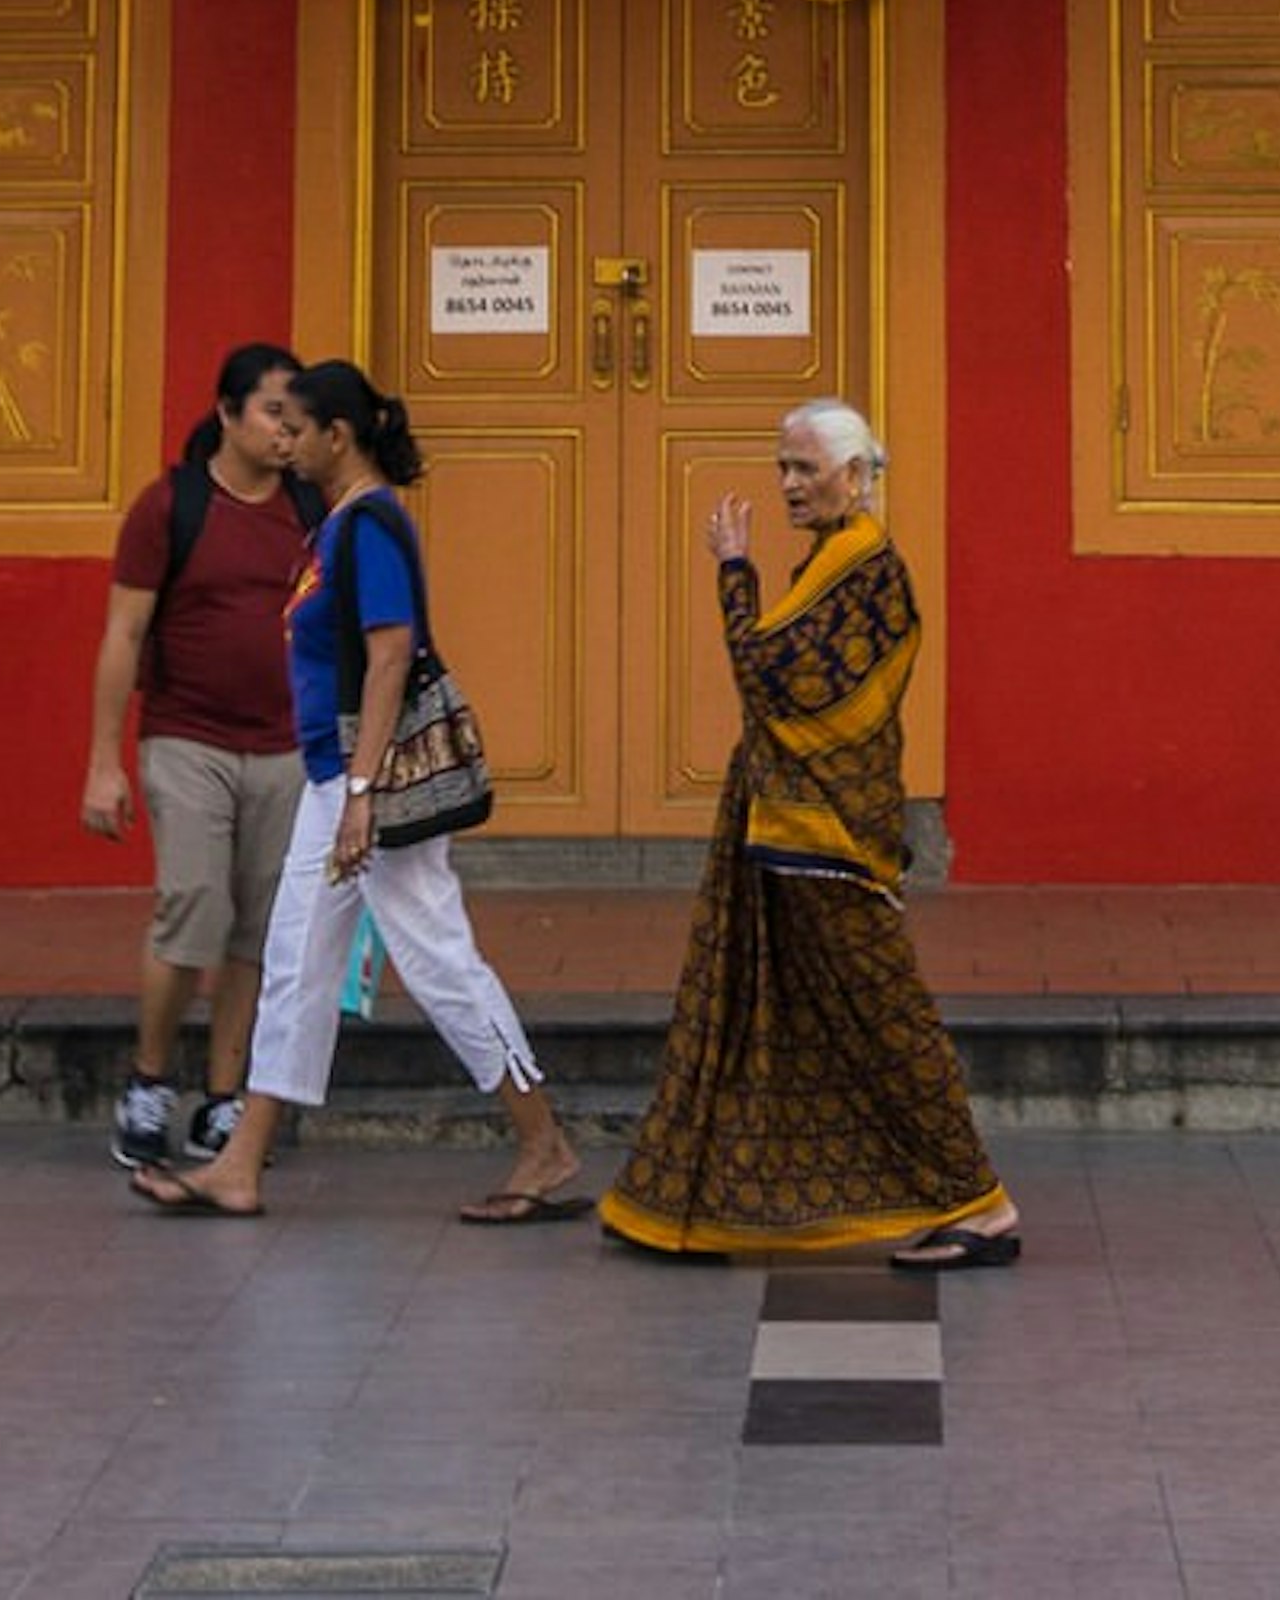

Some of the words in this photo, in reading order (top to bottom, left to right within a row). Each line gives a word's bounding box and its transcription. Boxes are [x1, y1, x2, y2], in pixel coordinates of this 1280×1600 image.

[445, 296, 487, 314] 8654
[492, 296, 535, 313] 0045
[711, 301, 749, 317] 8654
[753, 301, 793, 316] 0045
